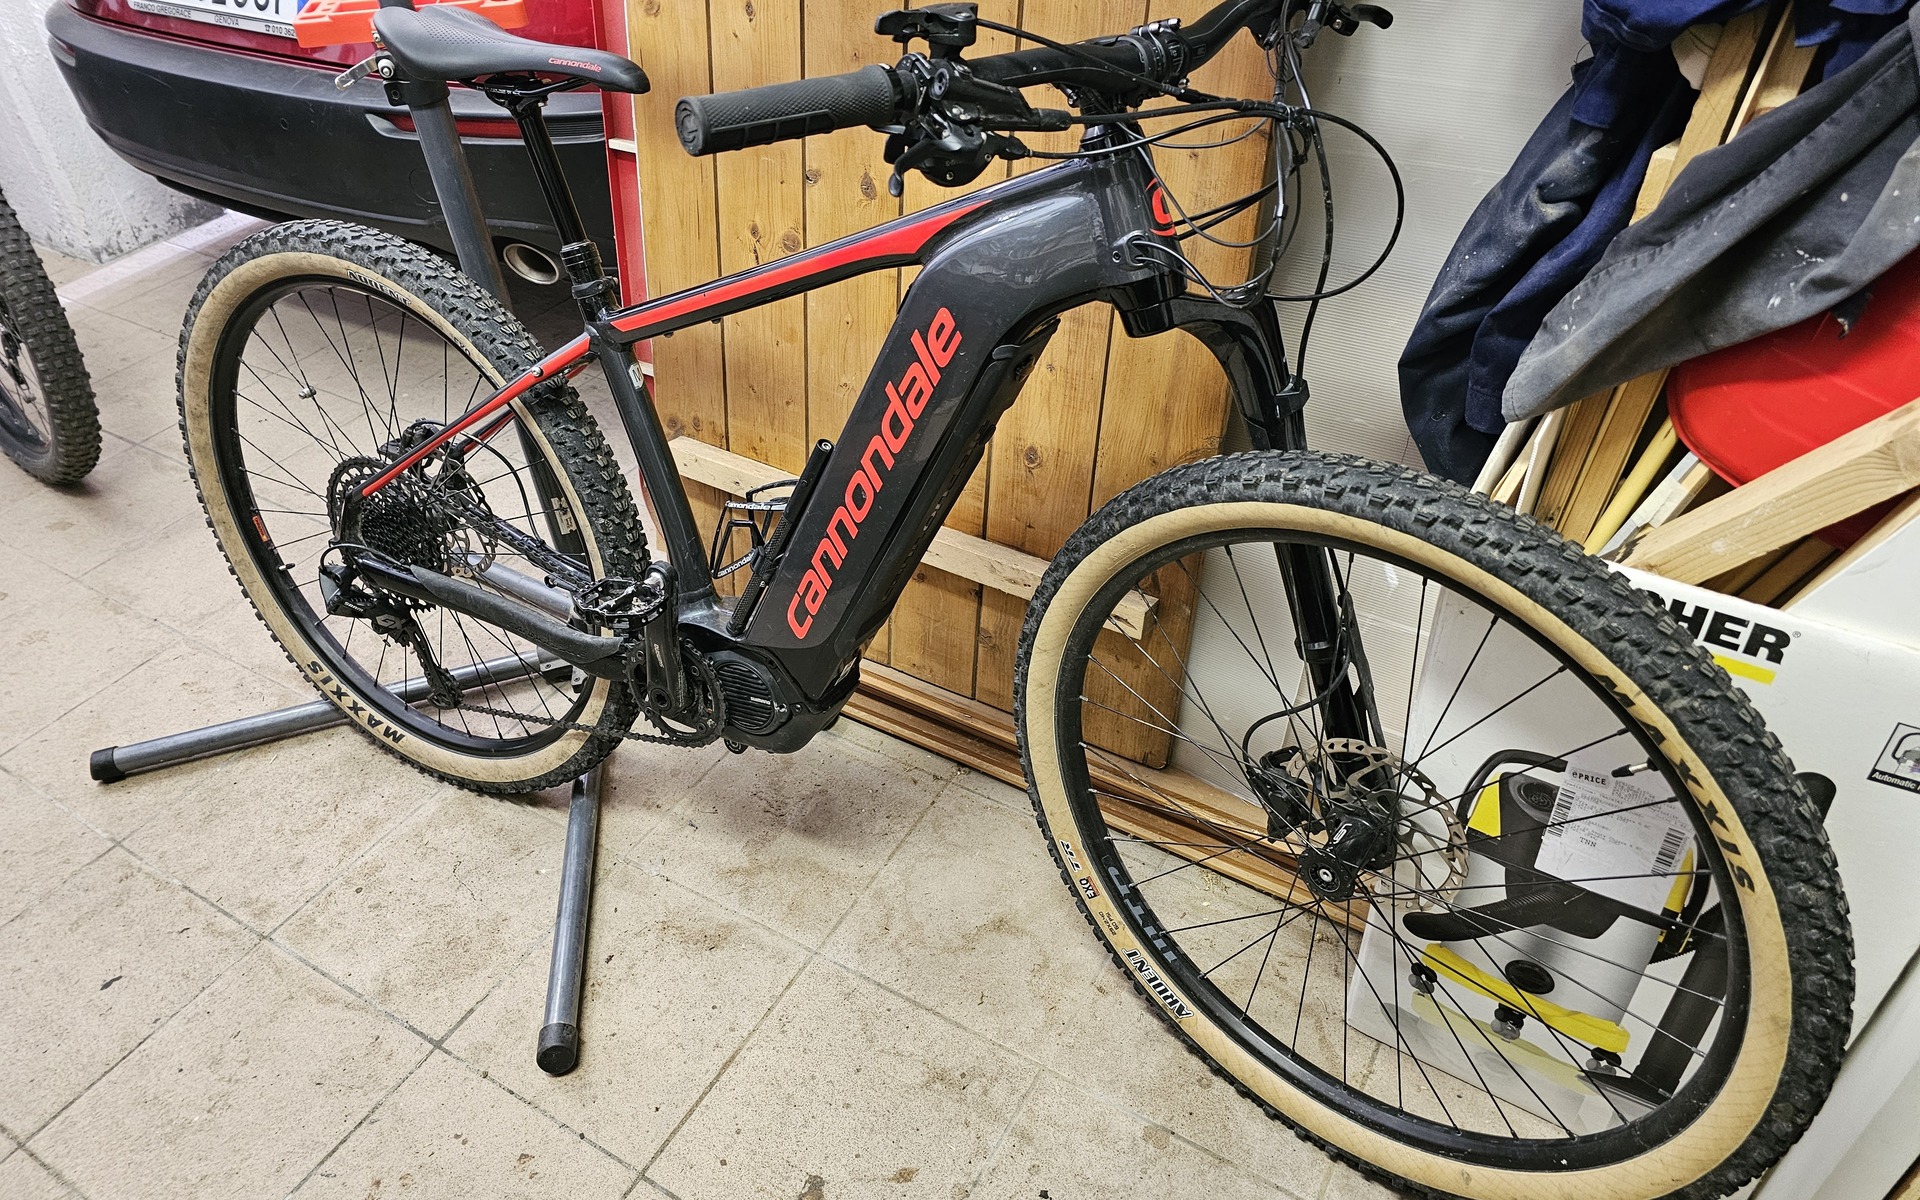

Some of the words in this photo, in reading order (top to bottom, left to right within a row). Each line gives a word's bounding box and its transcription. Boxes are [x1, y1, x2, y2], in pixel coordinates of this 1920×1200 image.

[133, 2, 155, 12] FRANCO
[156, 5, 192, 18] GREGORACE
[214, 14, 240, 27] GENOVA
[271, 24, 283, 34] 010
[548, 57, 602, 72] cannondale
[787, 307, 963, 639] cannondale
[306, 660, 406, 744] MAXXIS
[1571, 770, 1607, 786] ePRICE
[1597, 674, 1755, 893] MAXXIS
[1872, 772, 1916, 789] Automatic
[1060, 840, 1082, 872] TR
[1079, 878, 1097, 899] EXO
[1121, 947, 1194, 1019] ARDENT
